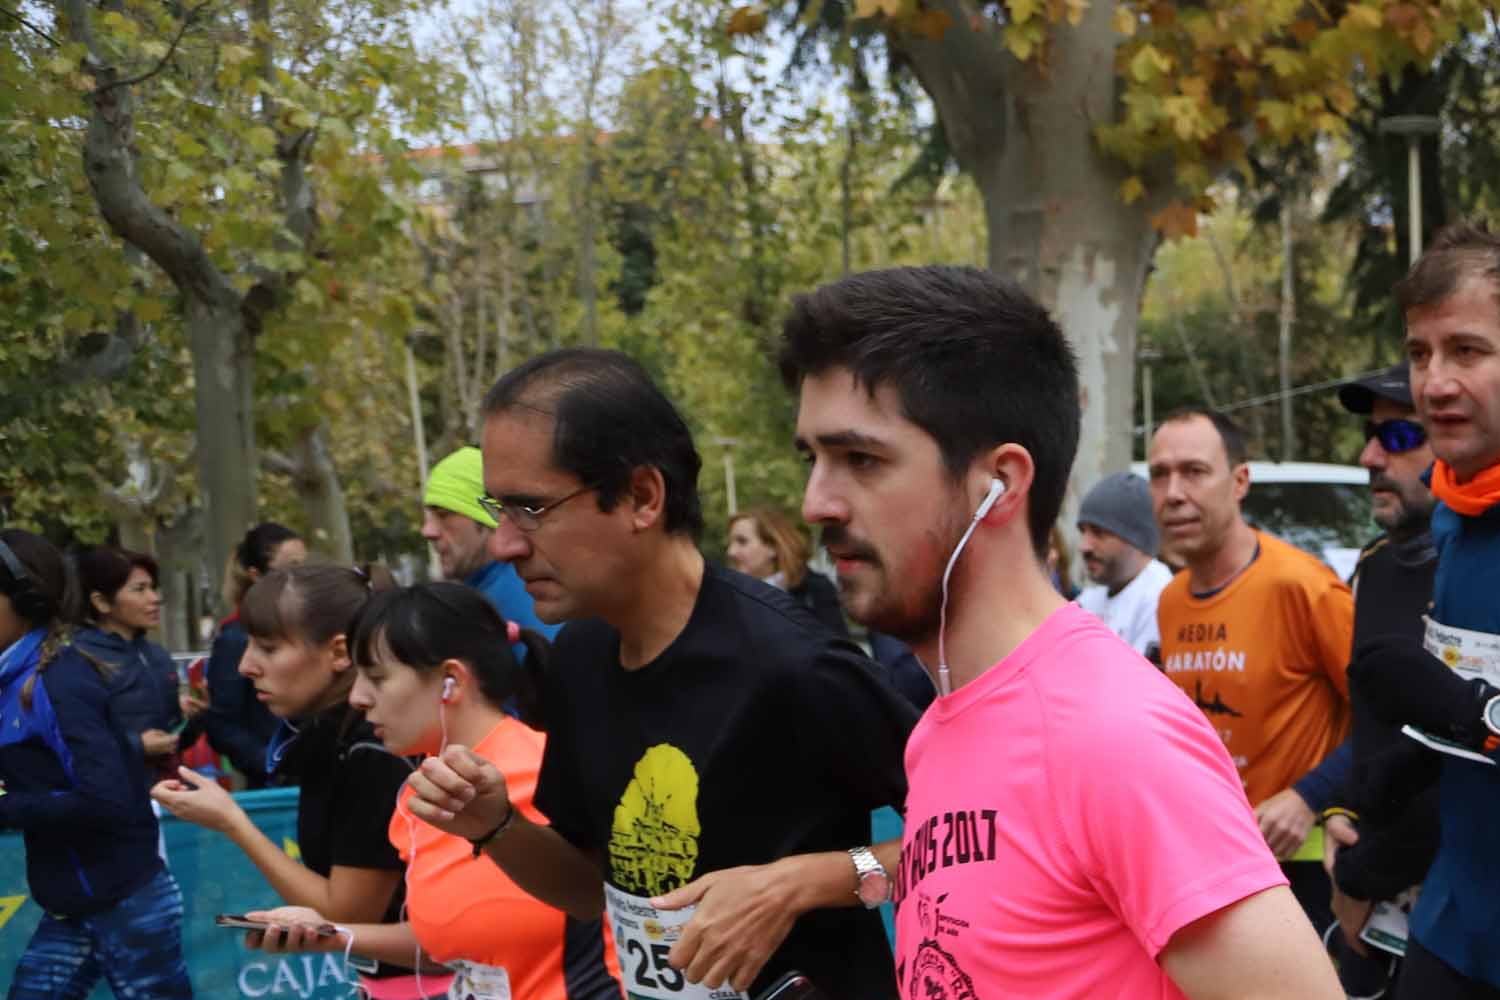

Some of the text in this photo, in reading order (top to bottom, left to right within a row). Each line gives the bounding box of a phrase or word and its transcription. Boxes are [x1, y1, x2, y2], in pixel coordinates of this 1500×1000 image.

[1178, 623, 1228, 642] MEDIA
[941, 809, 998, 869] 2017
[238, 953, 348, 999] CAJA
